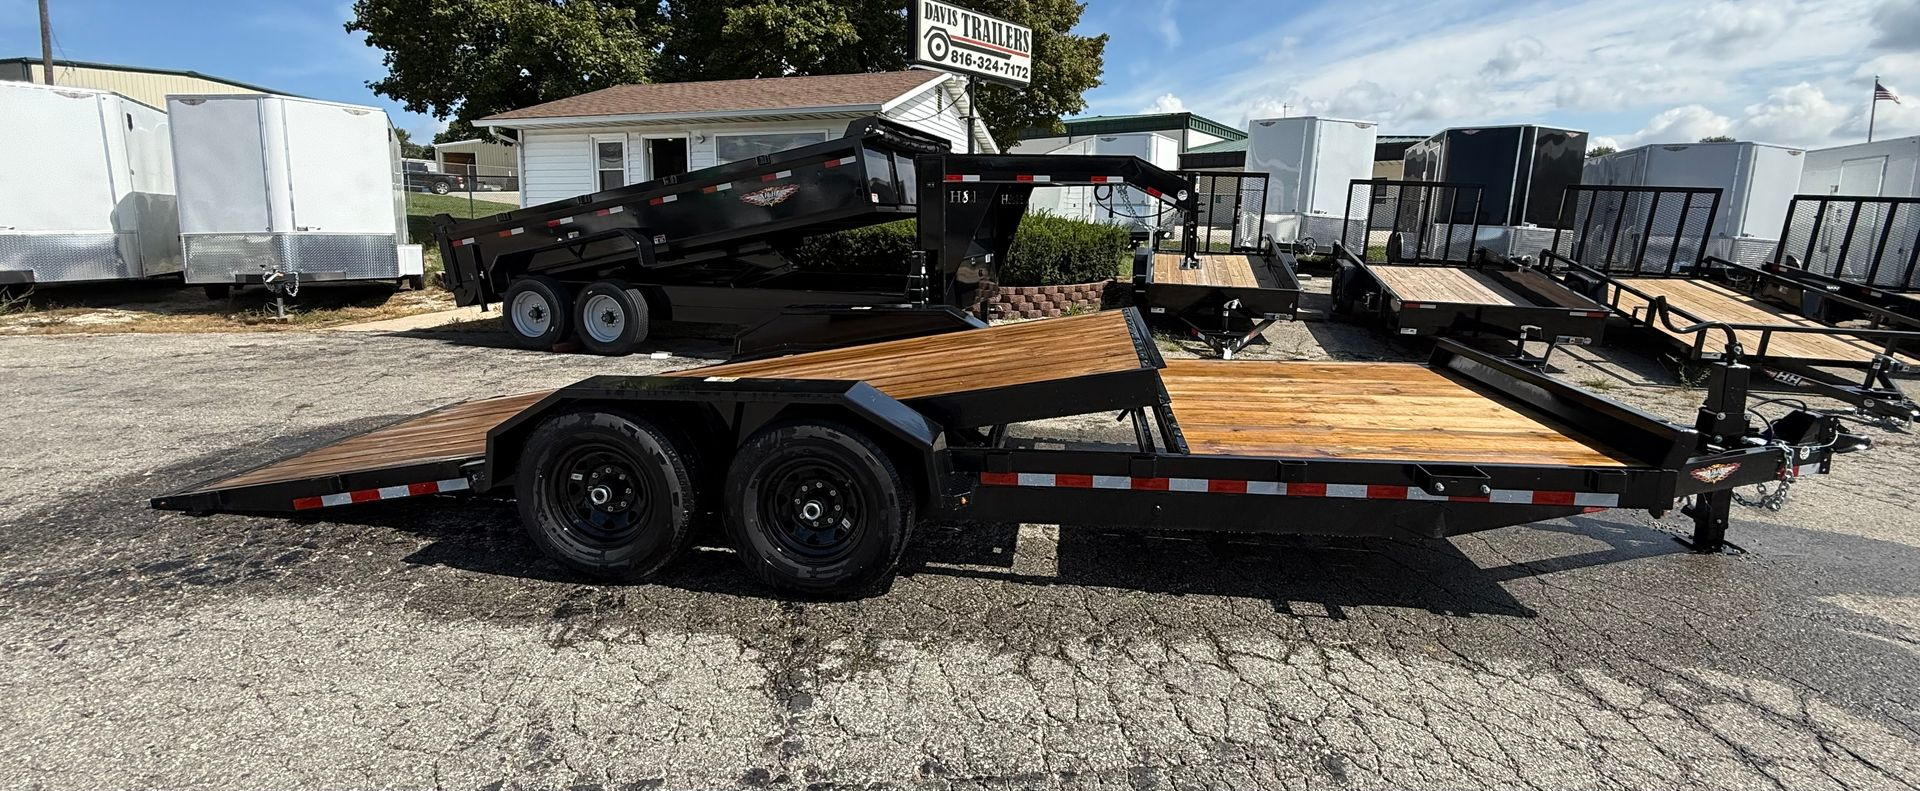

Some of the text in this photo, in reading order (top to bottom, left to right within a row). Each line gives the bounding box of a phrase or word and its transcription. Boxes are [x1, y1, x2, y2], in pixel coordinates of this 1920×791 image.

[924, 2, 1030, 53] DAVIS TRAILERS
[951, 50, 1029, 79] 816-324-7172
